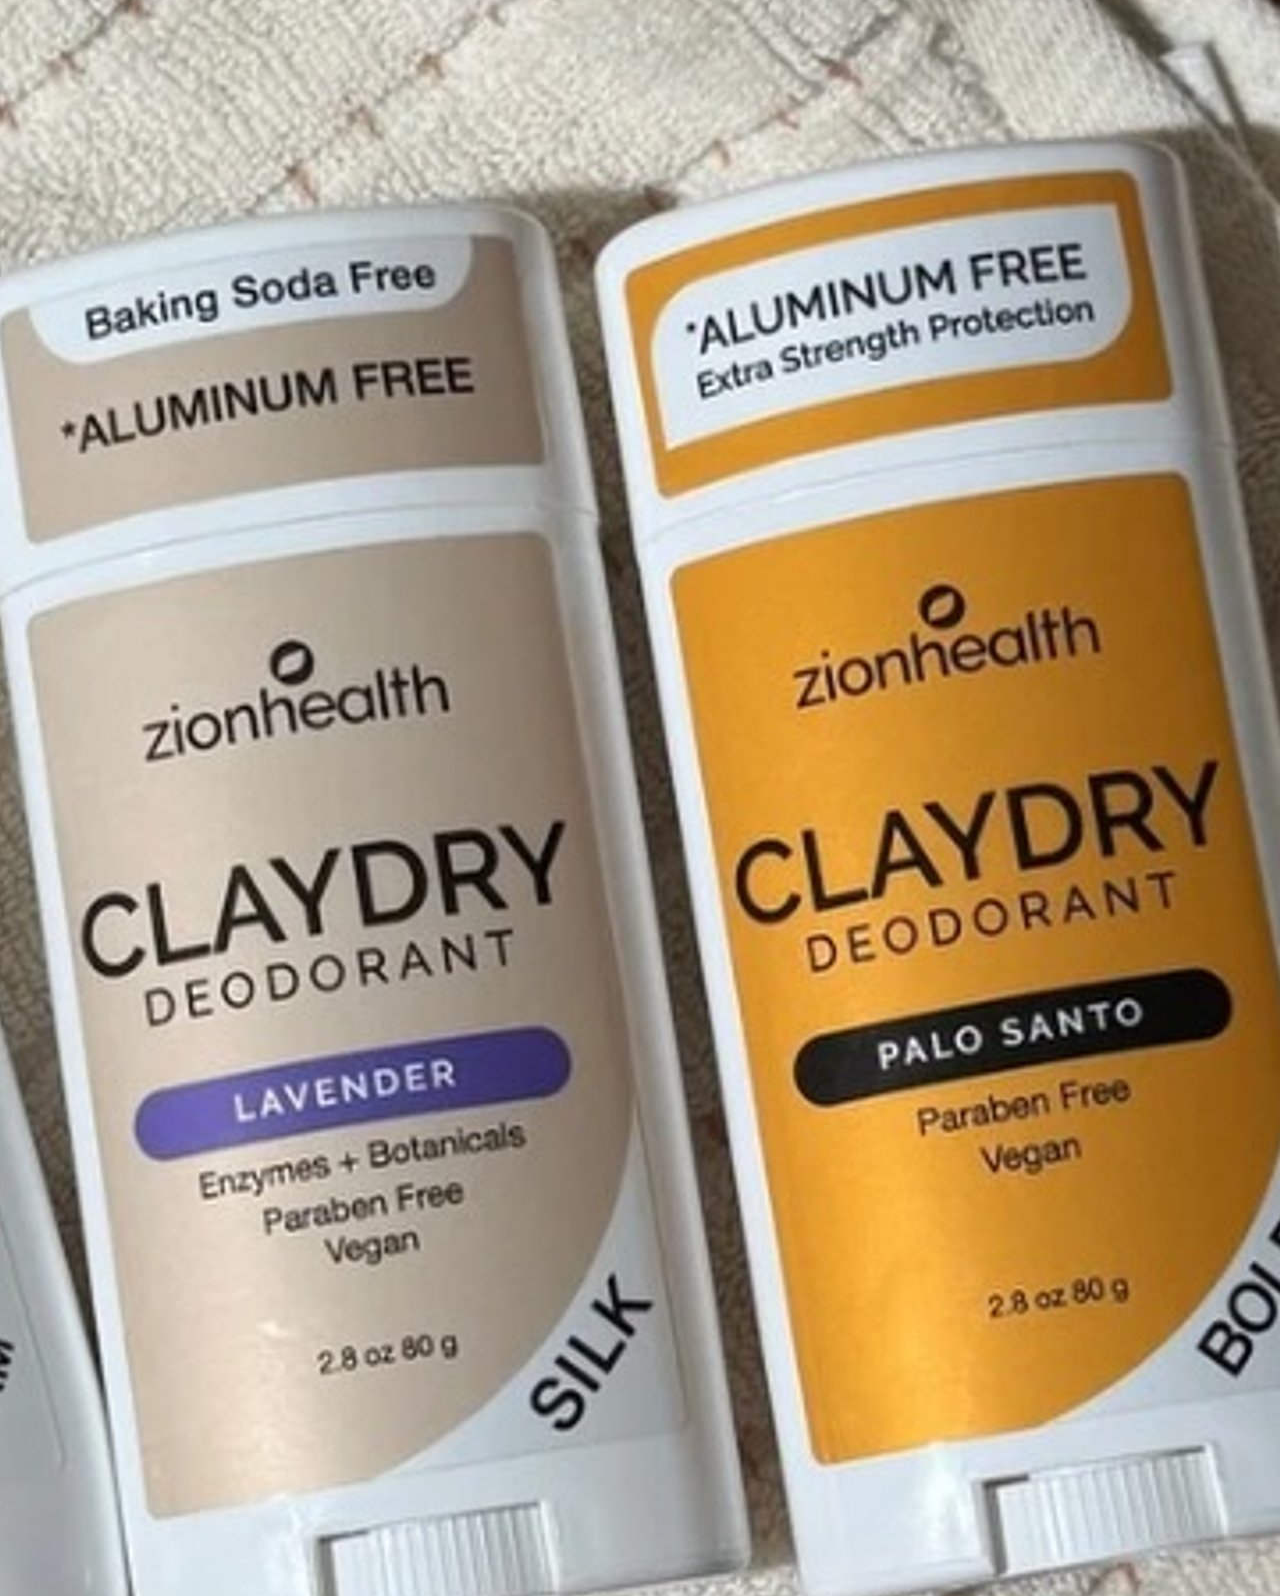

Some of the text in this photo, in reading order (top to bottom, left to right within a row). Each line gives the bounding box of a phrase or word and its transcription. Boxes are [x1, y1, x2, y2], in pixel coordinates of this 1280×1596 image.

[85, 260, 437, 341] Baking Soda Free
[969, 243, 1086, 287] FREE
[353, 358, 474, 401] FREE
[696, 300, 1095, 400] Extra Strength Protection
[794, 608, 1101, 708] zionhealth
[143, 664, 451, 763] zionhealth
[735, 761, 1219, 925] CLAYDRY
[81, 820, 567, 978] CLAYDRY
[806, 872, 1177, 973] DEODORANT
[144, 928, 515, 1027] DEODORANT
[877, 997, 1144, 1070] PALO SANTO
[234, 1058, 458, 1124] LAVENDER
[917, 1078, 1131, 1137] Paraben Free
[198, 1152, 330, 1200] Enzymes
[369, 1122, 527, 1170] Botanicals
[981, 1134, 1081, 1174] Vegan
[262, 1179, 465, 1236] Paraben Free
[324, 1229, 420, 1266] Vegan
[988, 1291, 1030, 1318] 2.8
[1034, 1283, 1067, 1310] oz
[1072, 1276, 1105, 1304] 80
[317, 1345, 359, 1376] 2.8
[364, 1340, 395, 1367] oz
[401, 1332, 433, 1360] 80
[529, 1273, 654, 1432] SILK
